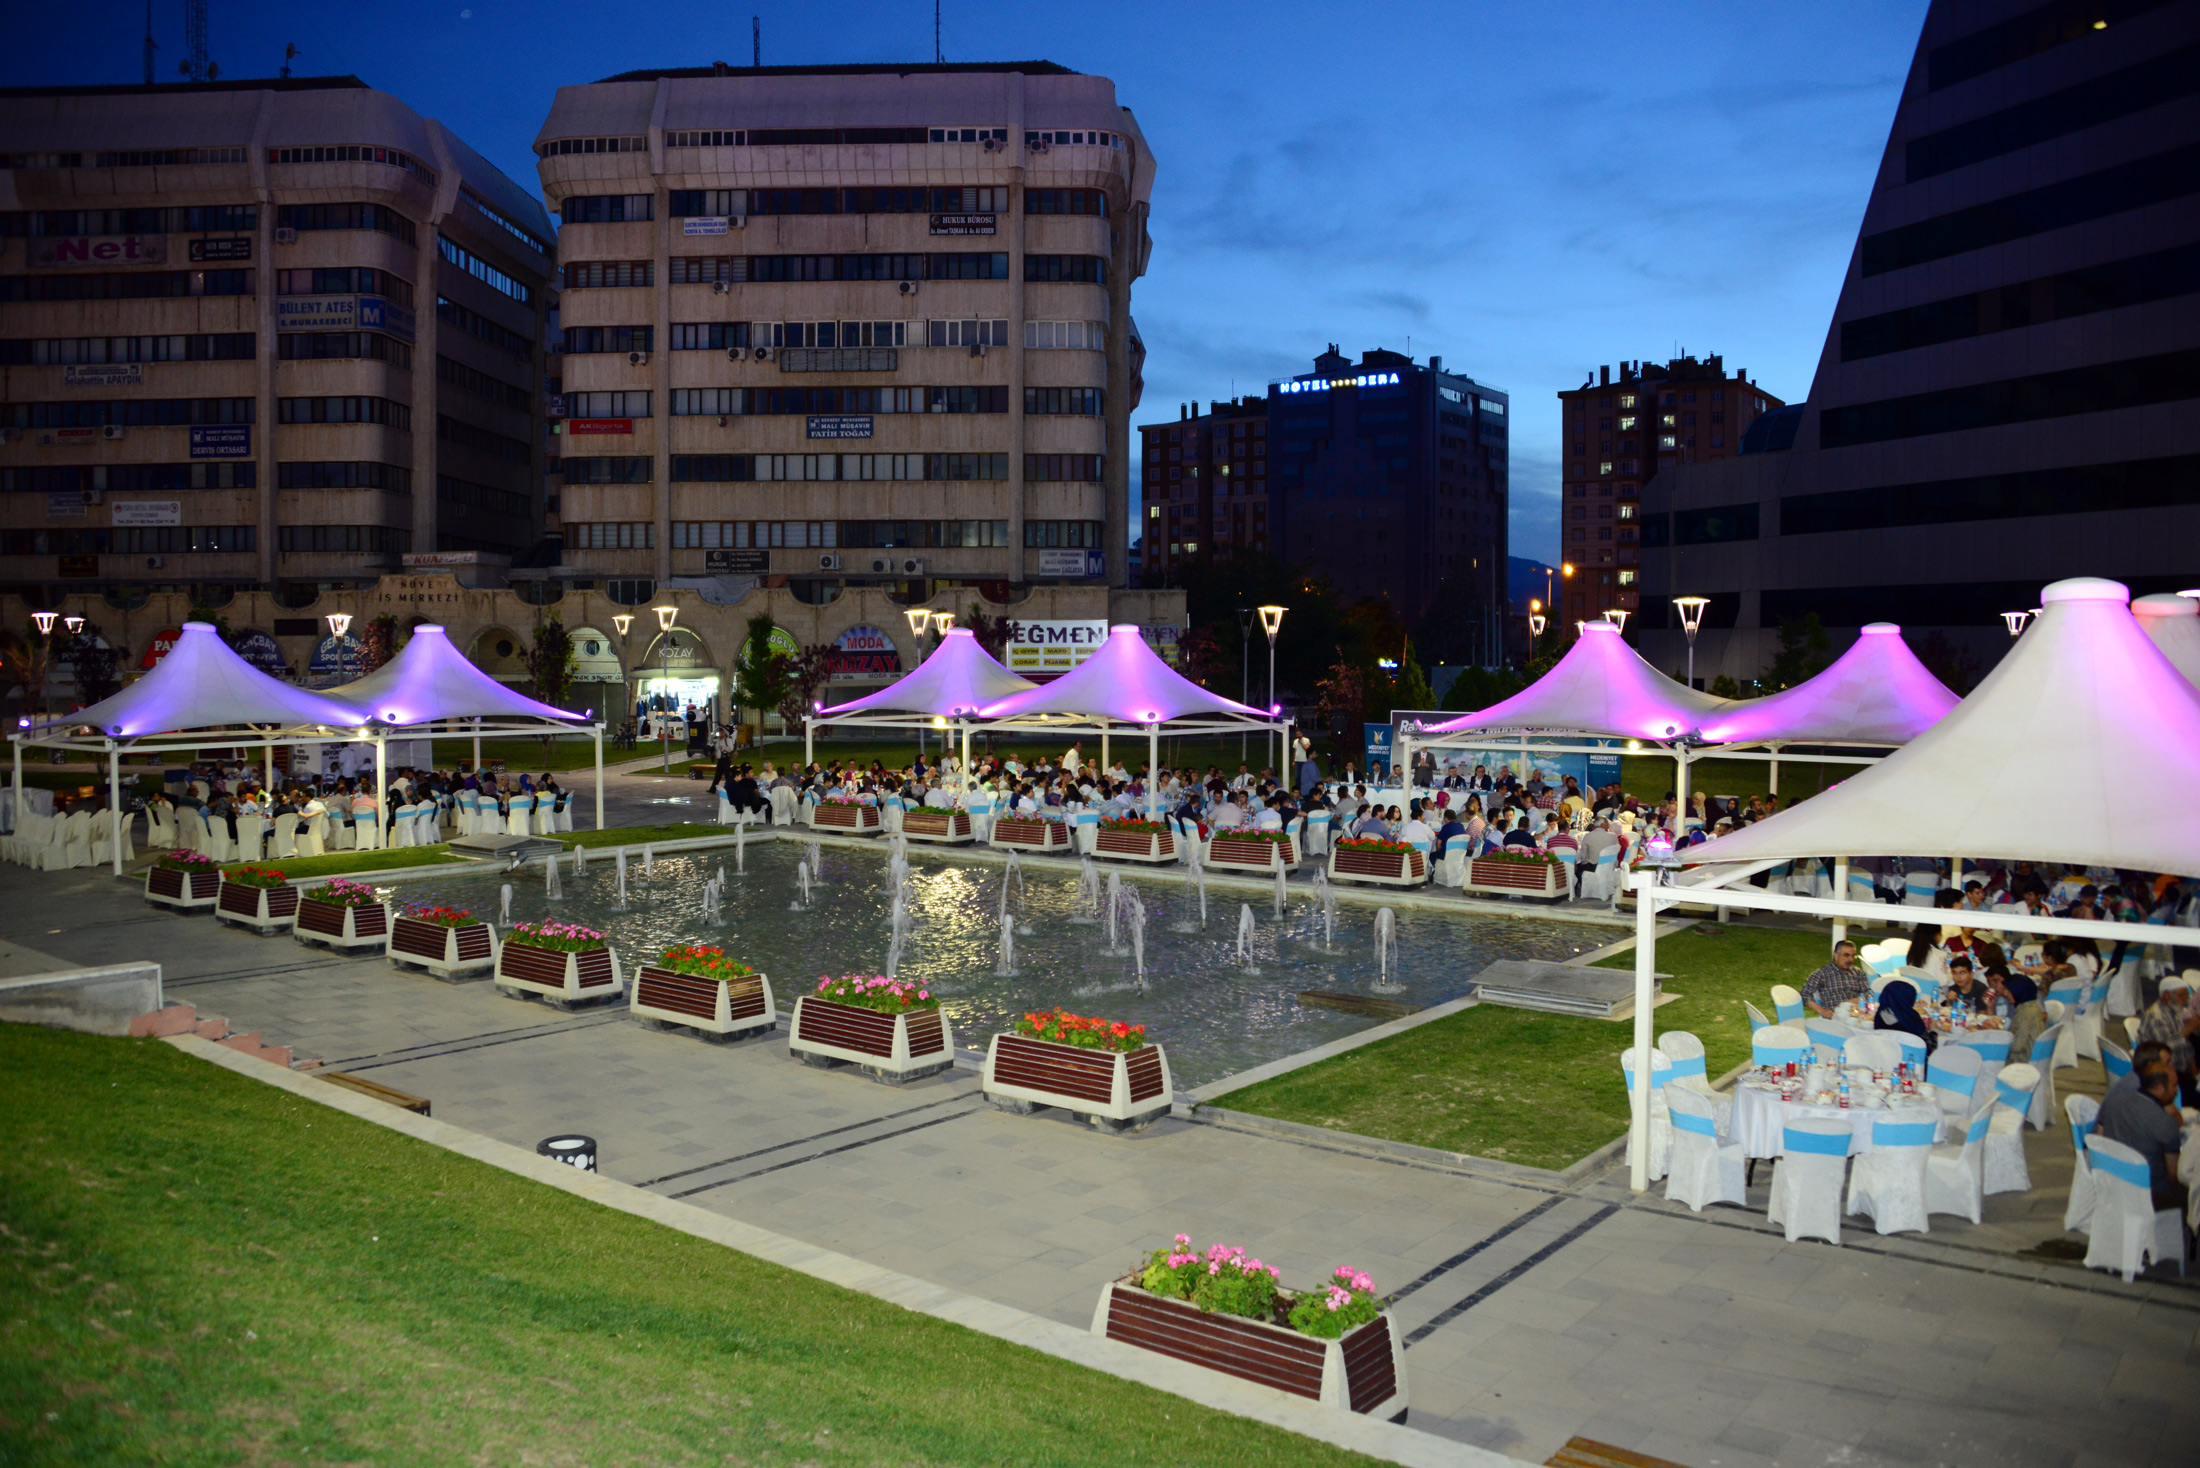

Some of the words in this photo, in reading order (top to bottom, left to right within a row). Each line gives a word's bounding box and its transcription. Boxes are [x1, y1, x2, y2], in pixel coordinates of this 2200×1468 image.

[942, 216, 966, 224] HUKUK
[967, 214, 994, 224] BÜROSU
[57, 236, 140, 261] Net
[278, 301, 322, 314] BÜLENT
[325, 301, 354, 314] ATEŞ
[1279, 378, 1330, 394] HOTEL
[1357, 372, 1400, 387] BERA
[811, 429, 838, 437] FATİH
[839, 429, 871, 437] TOĞAN
[398, 592, 459, 602] MERKEZİ
[1013, 624, 1104, 643] EĞMEN
[320, 635, 362, 654] GENBAY
[847, 637, 885, 650] MODA
[658, 647, 694, 658] KOZAY
